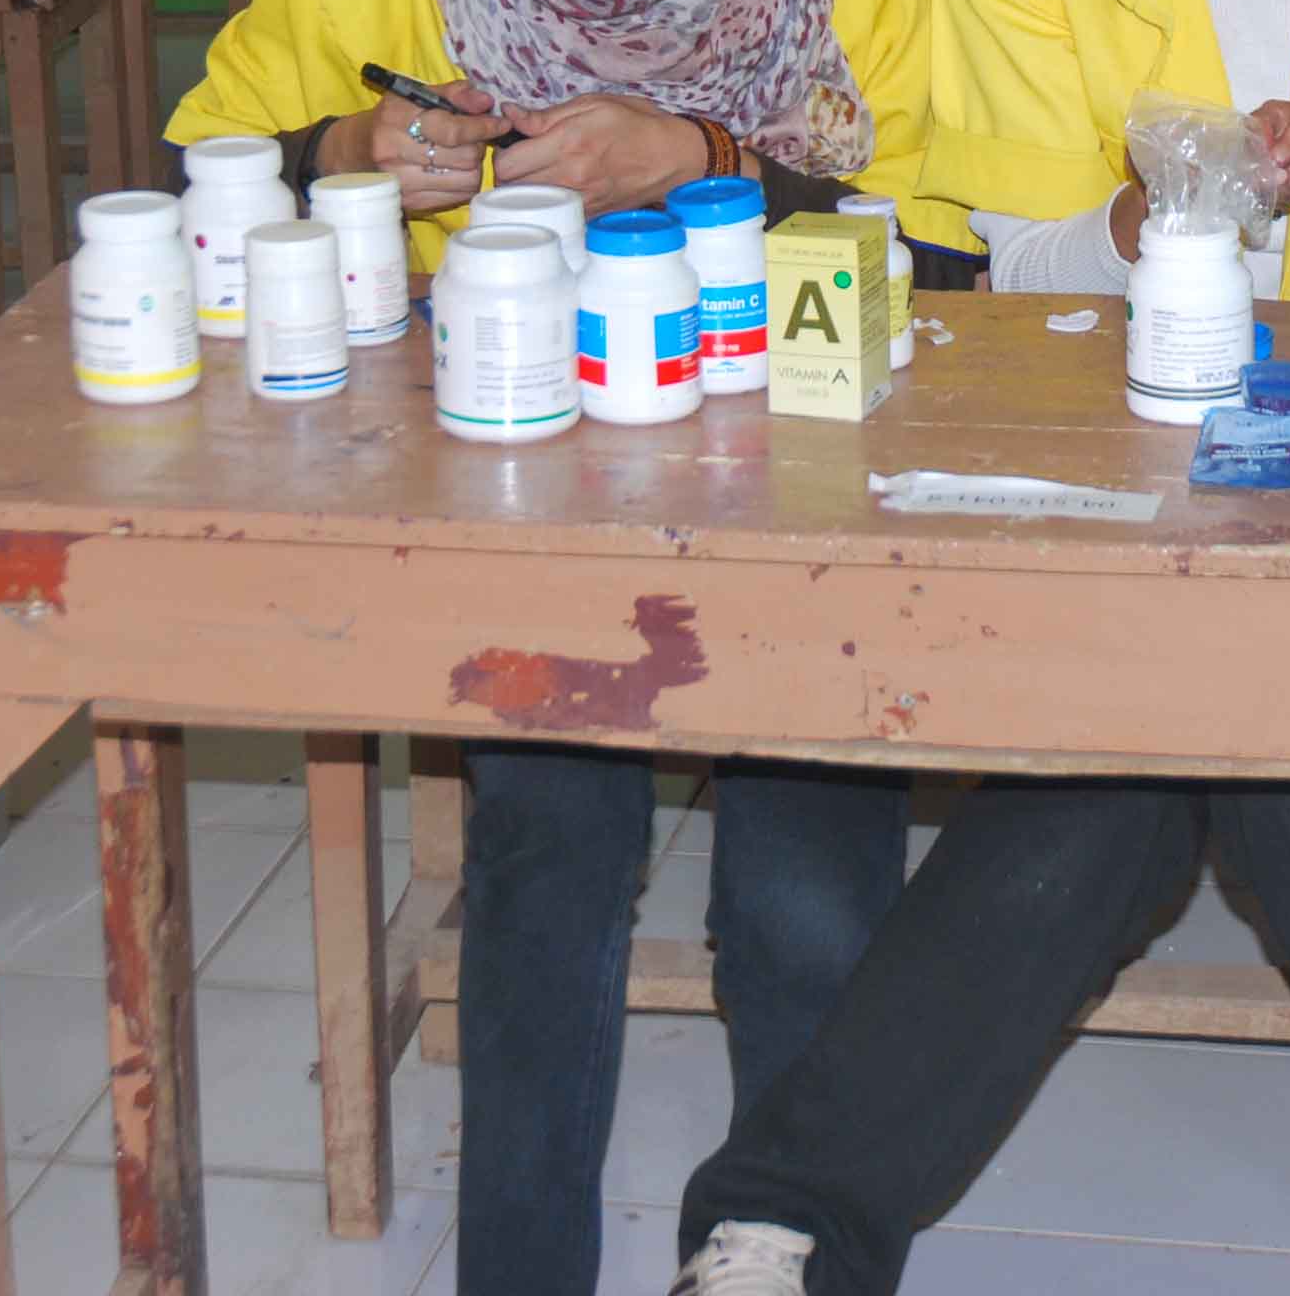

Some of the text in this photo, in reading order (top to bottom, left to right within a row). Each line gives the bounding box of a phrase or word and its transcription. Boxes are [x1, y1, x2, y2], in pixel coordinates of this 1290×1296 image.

[702, 293, 759, 312] tamin C
[783, 280, 840, 343] A
[778, 368, 850, 385] VITAMIN A
